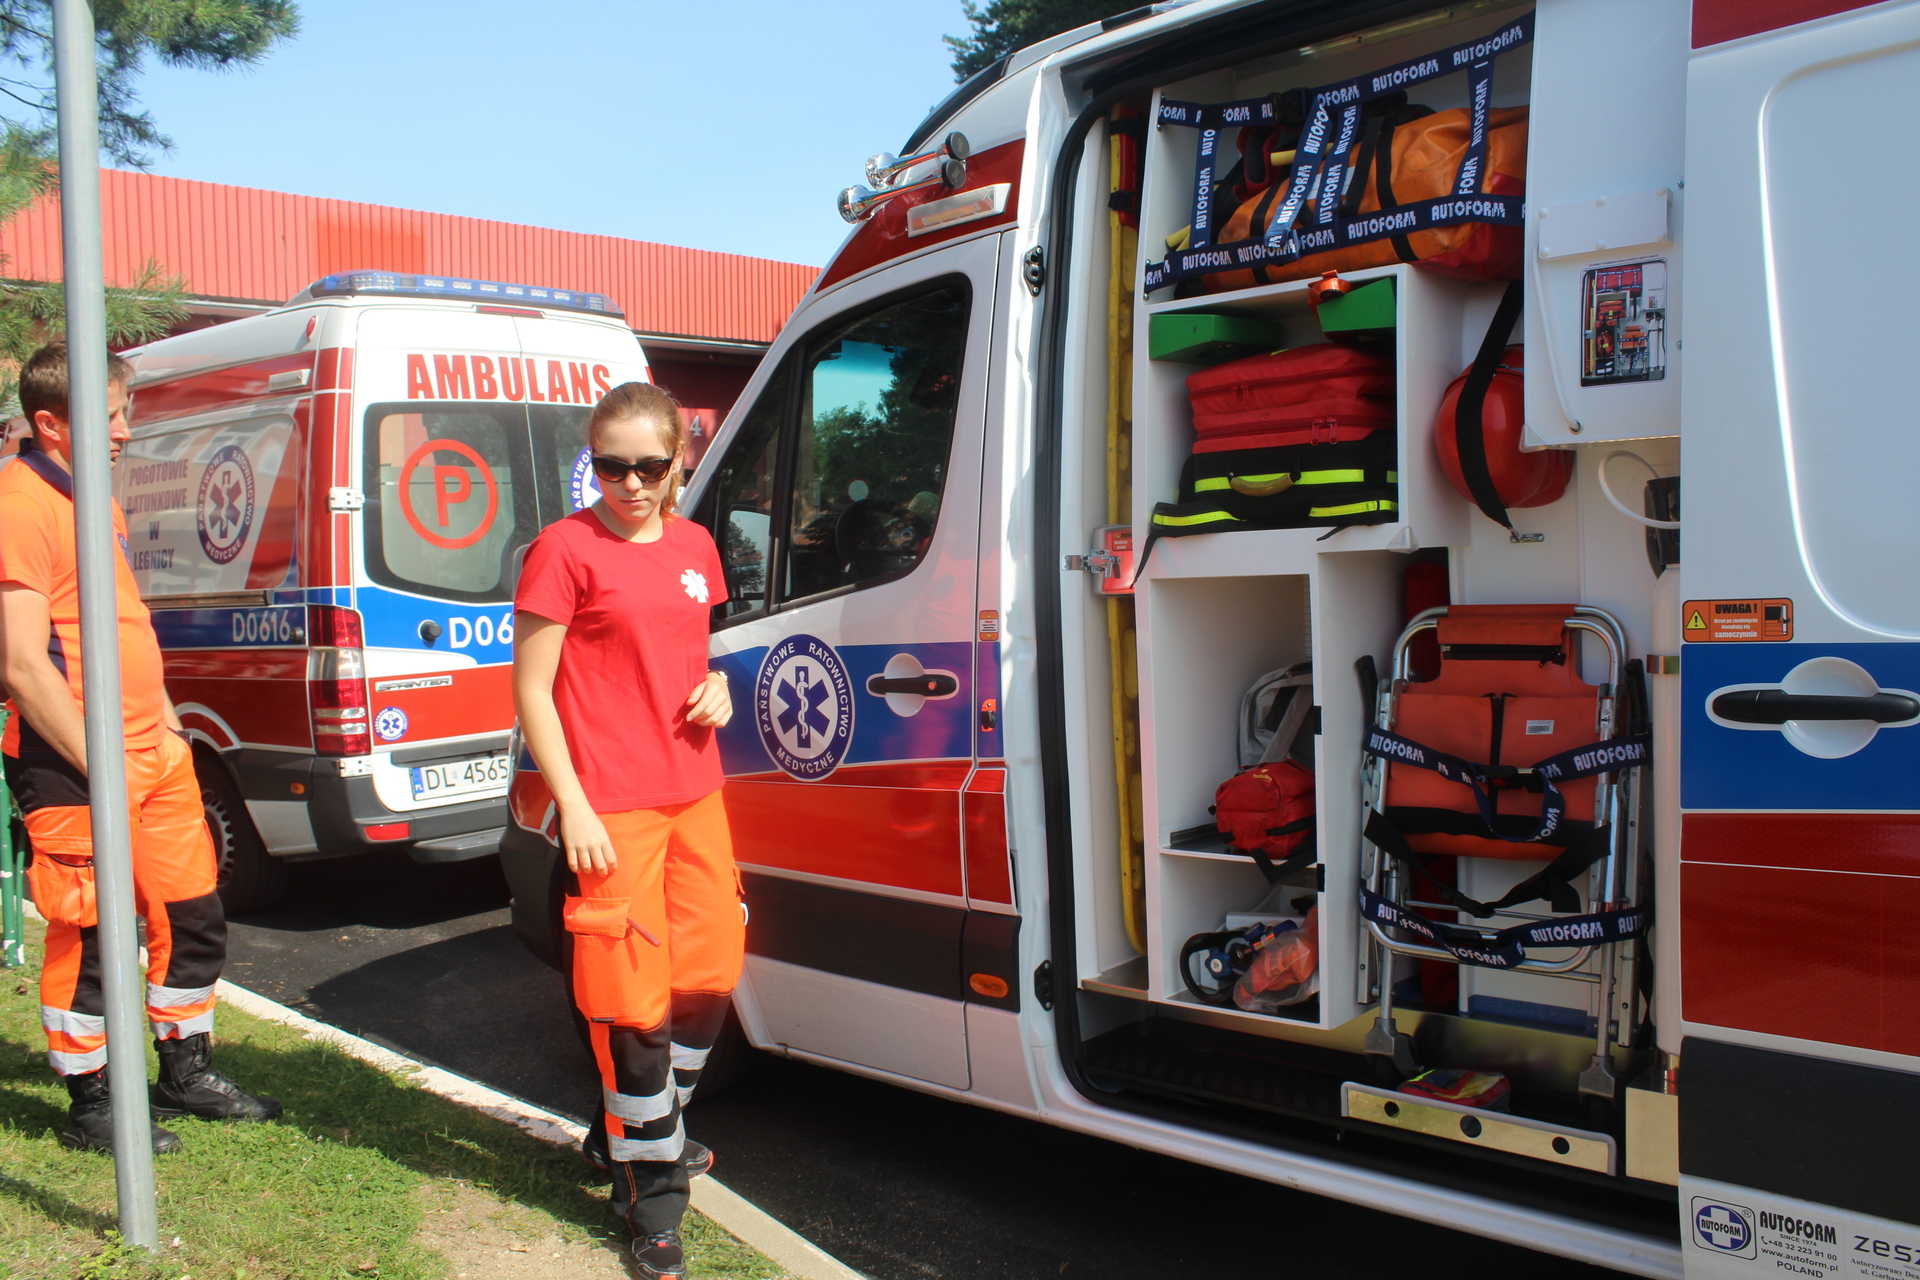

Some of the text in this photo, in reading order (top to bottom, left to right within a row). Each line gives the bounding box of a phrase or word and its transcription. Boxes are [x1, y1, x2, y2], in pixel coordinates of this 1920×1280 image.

[1453, 25, 1522, 66] AUTOFORM
[1372, 58, 1438, 92] AUTOFORM
[1223, 106, 1250, 122] ORM
[1471, 78, 1488, 147] AUTOFORM
[1304, 104, 1329, 154] AUTOFO
[1334, 106, 1356, 155] AUTOFOR
[1195, 167, 1211, 230] AUTOFORM
[1277, 164, 1313, 224] AUTOFORM
[1348, 211, 1416, 239] AUTOFORM
[1431, 201, 1505, 221] AUTOFORM
[1182, 250, 1232, 271] AUTOFORM
[407, 354, 612, 405] AMBULANS
[689, 415, 701, 436] 4
[129, 459, 189, 487] POGOTOWIE
[574, 449, 592, 509] AŃSTWO
[126, 488, 188, 515] RATUNKOWE
[232, 450, 254, 525] RATOWNICTWO
[433, 465, 472, 527] P
[149, 521, 160, 541] W
[134, 548, 174, 571] LEGNICY
[205, 538, 242, 560] MEDYCZNE
[1715, 604, 1751, 614] UWAGA
[232, 609, 291, 643] D0616
[449, 613, 514, 649] D06
[377, 678, 451, 692] SPRINTER
[759, 642, 849, 738] PAŃSTWOWE RATOWNICTWO
[776, 747, 835, 774] MEDYCZNE
[1573, 743, 1646, 772] AUTOFORM
[425, 767, 456, 790] DL
[463, 759, 508, 784] 4565
[1530, 921, 1604, 942] AUTOFORM
[1701, 1218, 1741, 1237] AUTOFORM
[1760, 1210, 1837, 1245] AUTOFORM
[1780, 1233, 1800, 1242] SINCE
[1761, 1248, 1839, 1272] www.autoform.pl
[1768, 1239, 1837, 1261] +48 32 223 91 00
[1777, 1260, 1823, 1279] POLAND
[1851, 1258, 1903, 1276] Autoryzowany
